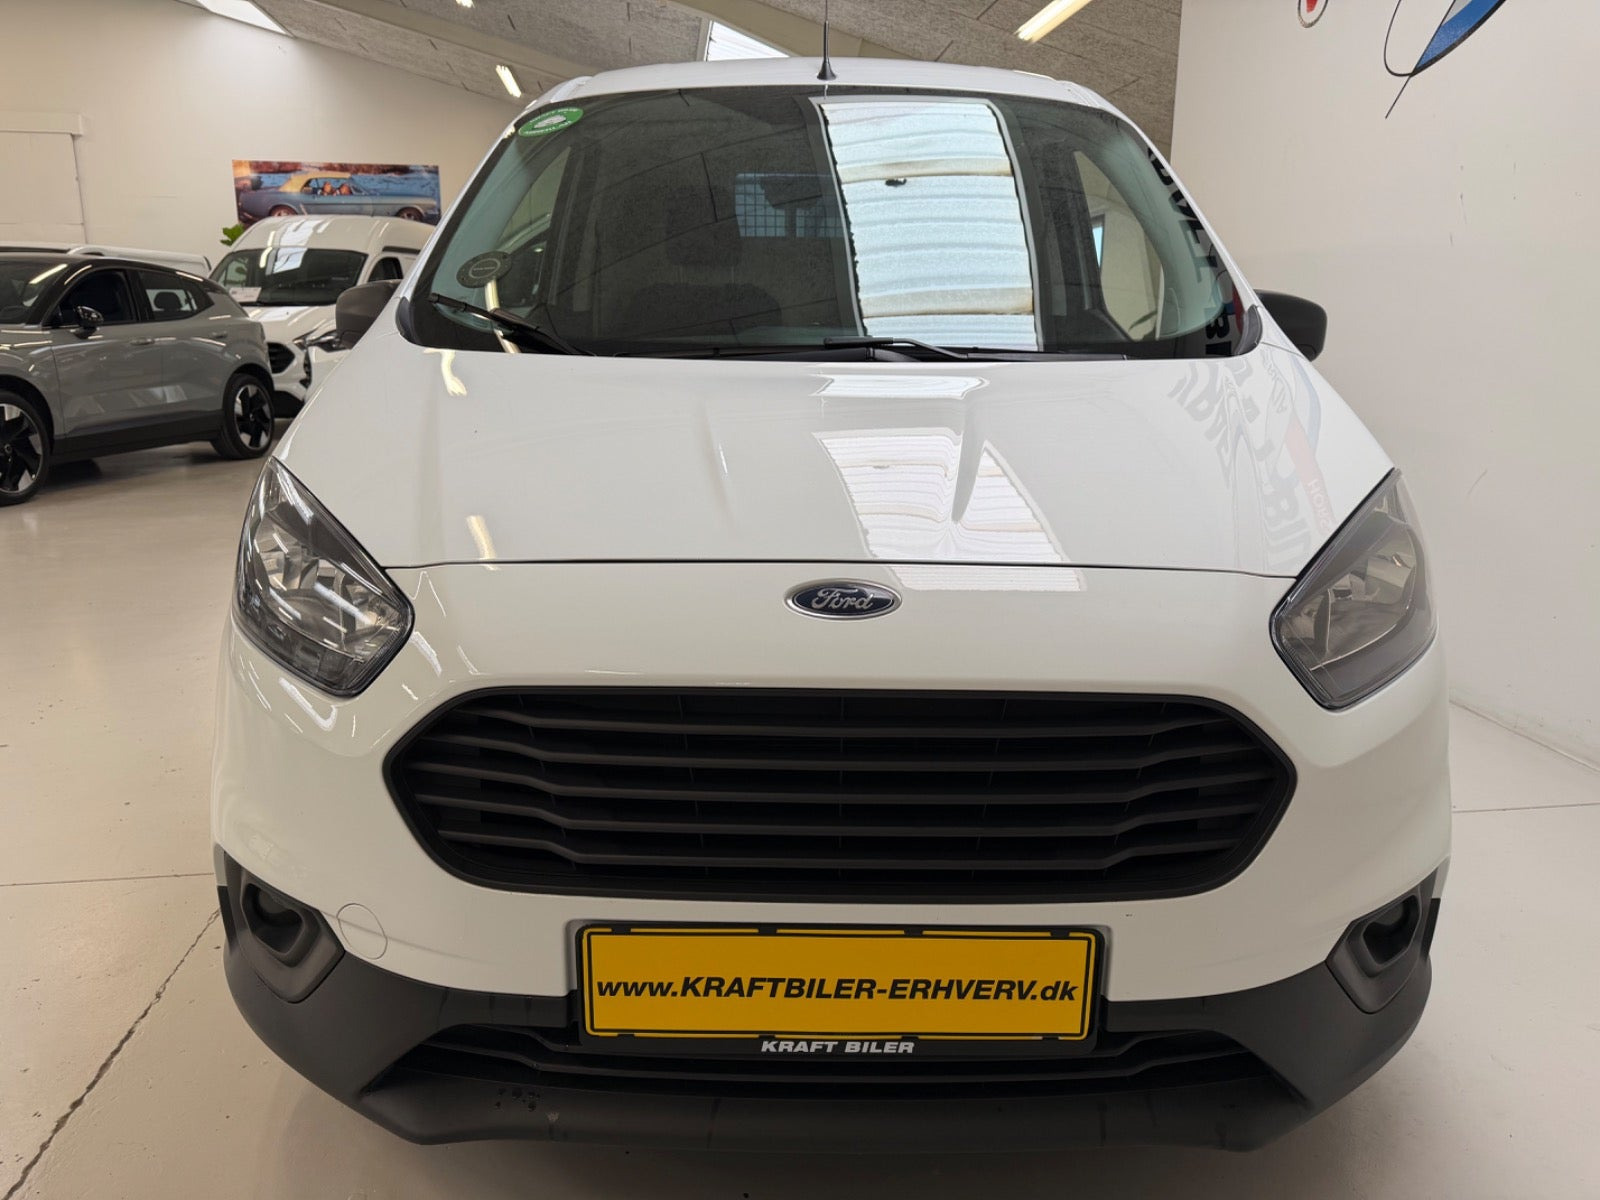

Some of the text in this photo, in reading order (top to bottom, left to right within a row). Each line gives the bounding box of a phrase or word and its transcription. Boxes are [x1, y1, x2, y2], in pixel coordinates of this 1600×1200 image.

[811, 587, 873, 609] Ford
[597, 977, 1078, 1001] www.KRAFTBILER-ERHVERV.dk
[761, 1040, 915, 1054] KRAFT BILER
